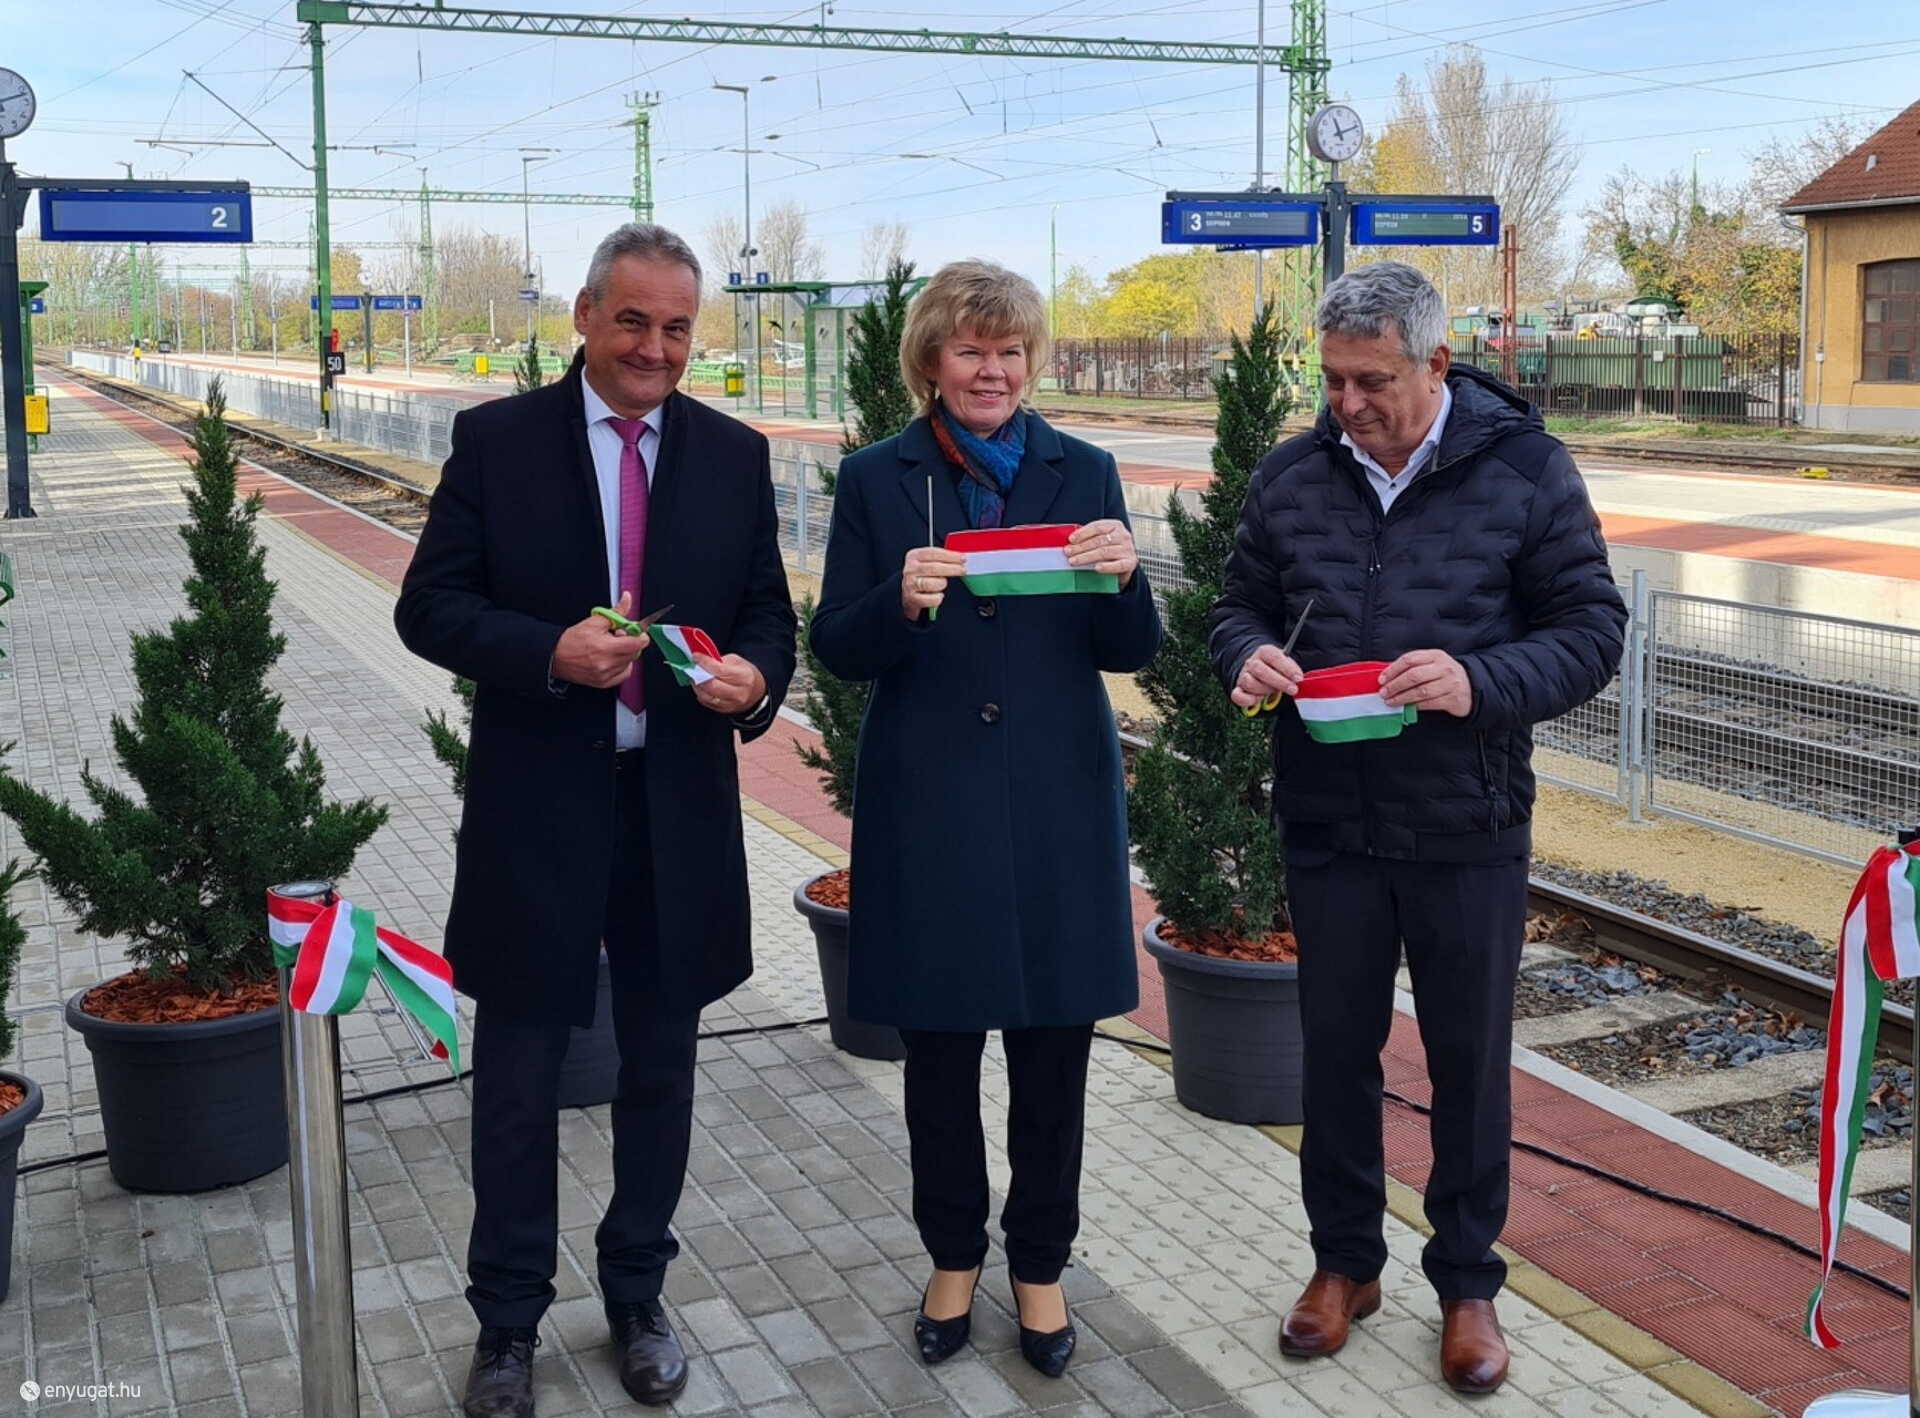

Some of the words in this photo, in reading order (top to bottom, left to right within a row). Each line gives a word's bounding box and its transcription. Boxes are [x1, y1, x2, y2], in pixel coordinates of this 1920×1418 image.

[211, 207, 227, 227] 2
[1190, 212, 1202, 231] 3
[1472, 215, 1483, 233] 5
[327, 357, 342, 371] 50
